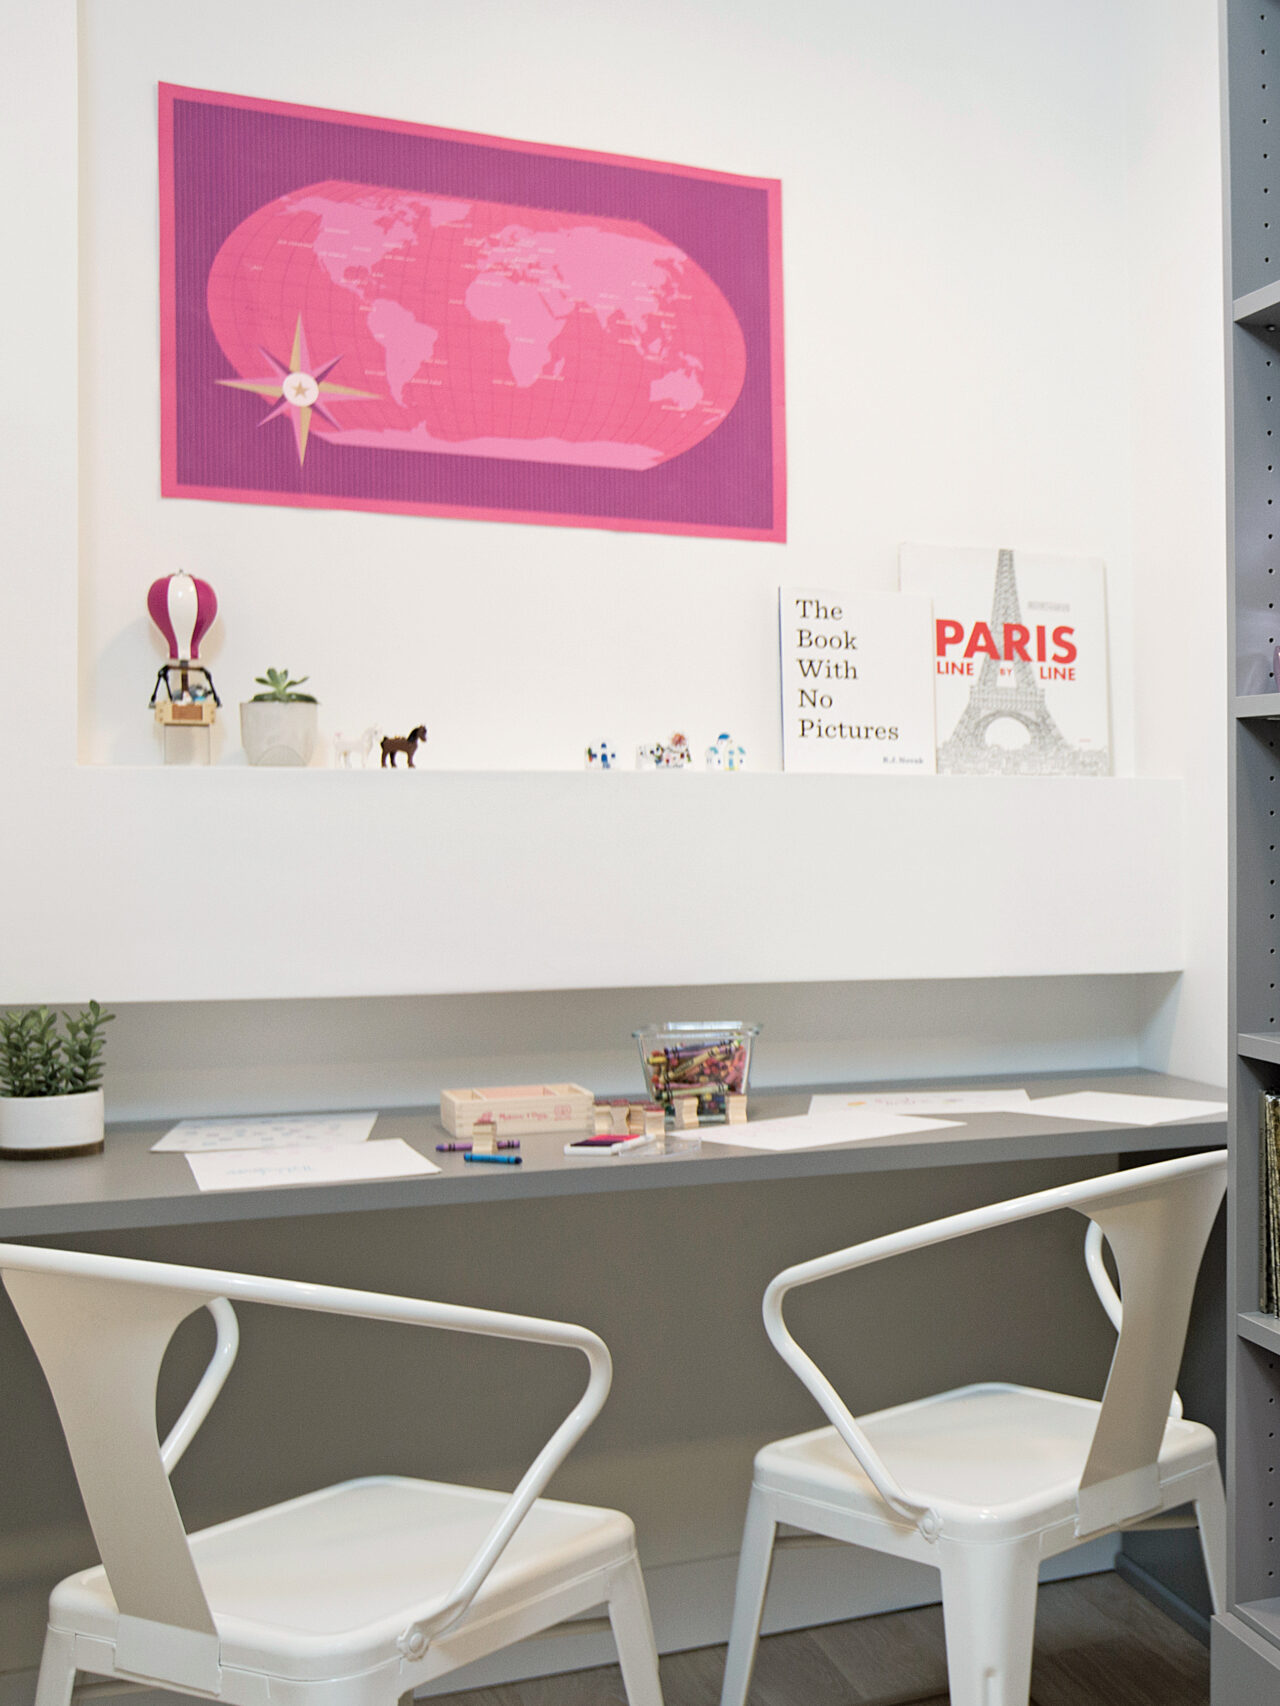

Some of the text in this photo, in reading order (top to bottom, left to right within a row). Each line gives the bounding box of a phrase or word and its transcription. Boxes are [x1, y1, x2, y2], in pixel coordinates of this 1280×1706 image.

[796, 599, 843, 621] The
[797, 630, 858, 651] Book
[936, 618, 1078, 664] PARIS
[797, 659, 858, 680] With
[937, 661, 974, 676] LINE
[1000, 668, 1012, 676] BY
[1040, 666, 1076, 681] LINE
[799, 689, 834, 709] No
[799, 720, 899, 741] Pictures
